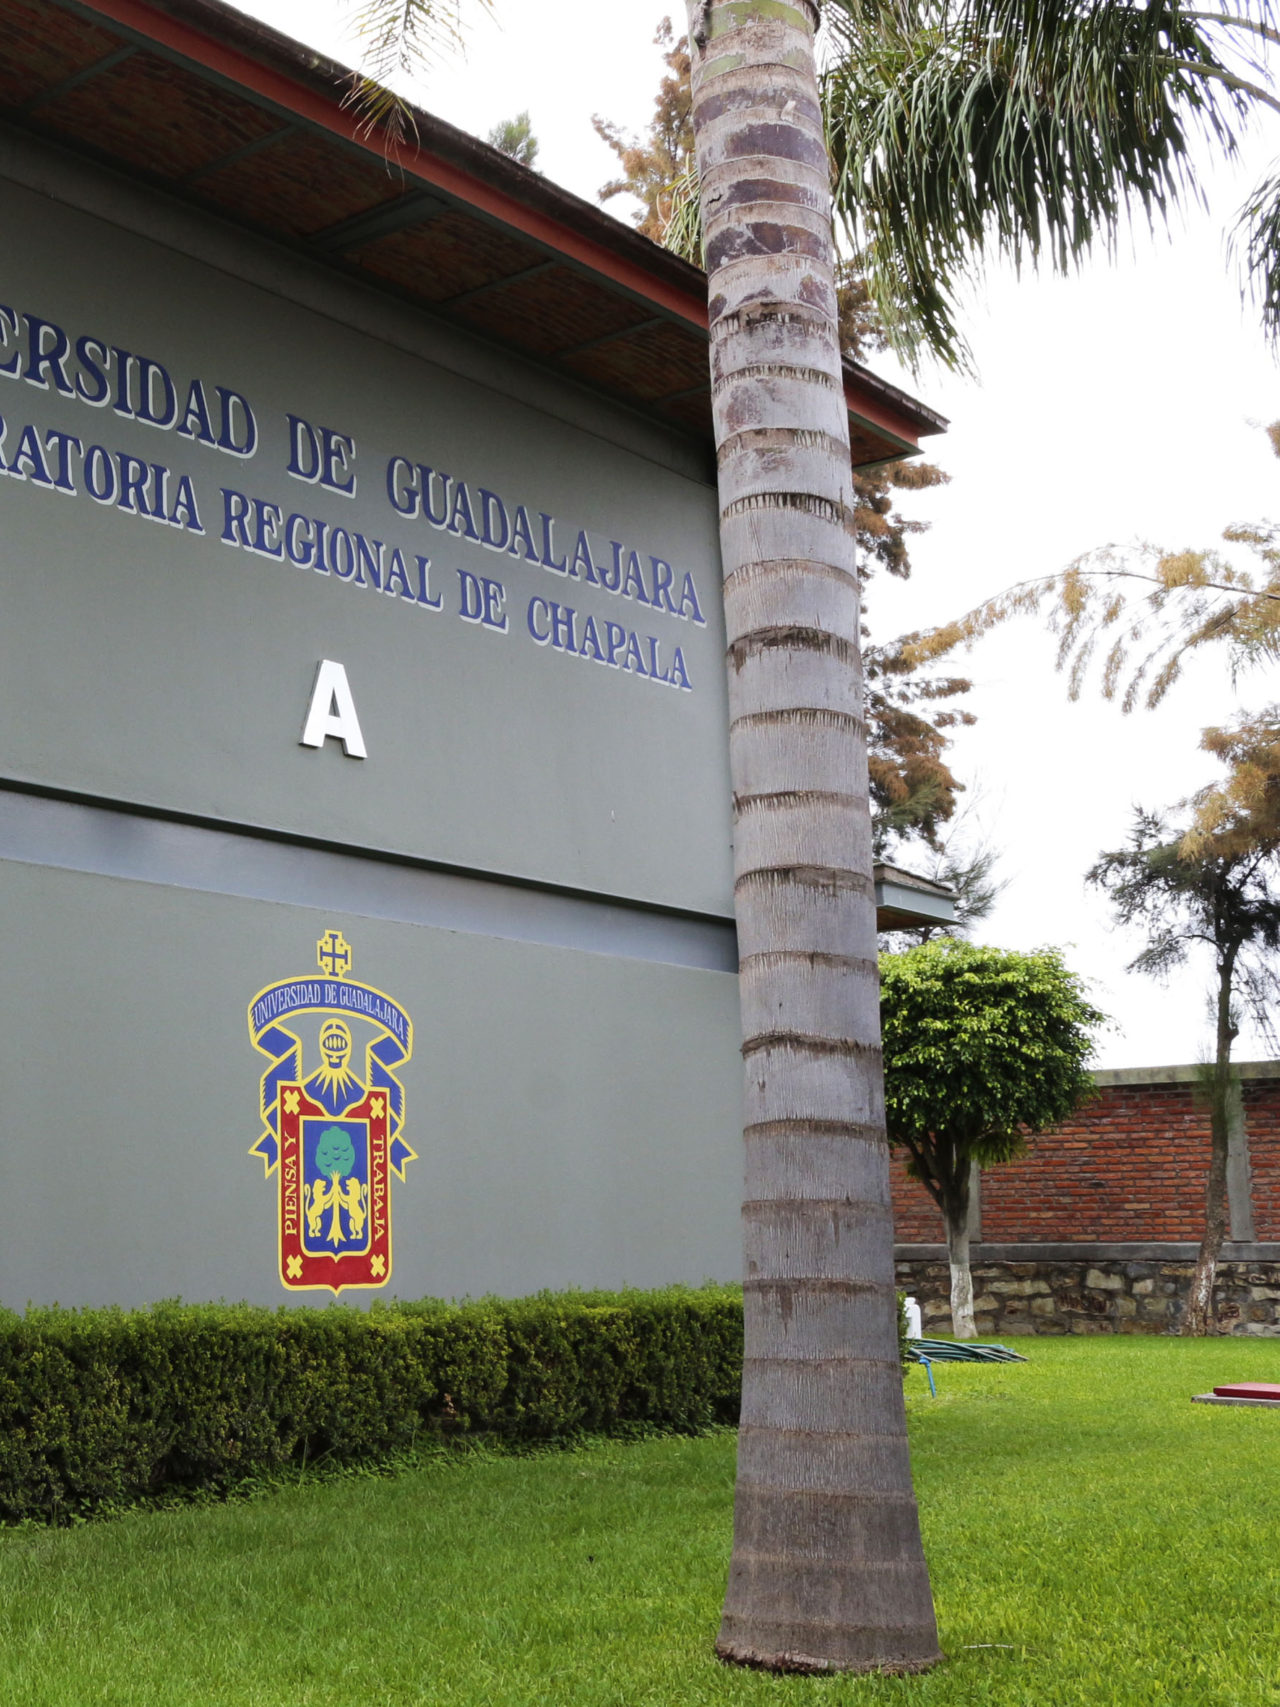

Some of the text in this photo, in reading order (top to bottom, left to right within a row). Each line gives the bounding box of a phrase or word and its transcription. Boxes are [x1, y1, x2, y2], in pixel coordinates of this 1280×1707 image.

[286, 413, 357, 498] DE
[386, 455, 707, 628] GUADALAJARA
[220, 487, 444, 612] REGIONAL
[457, 569, 510, 635] DE
[526, 596, 693, 692] CHAPALA
[298, 659, 368, 760] A
[254, 983, 405, 1040] UNIVERSIDAD DE GUADALAJARA
[284, 1130, 297, 1236] PIENSA Y
[372, 1134, 386, 1242] TRABAJA
